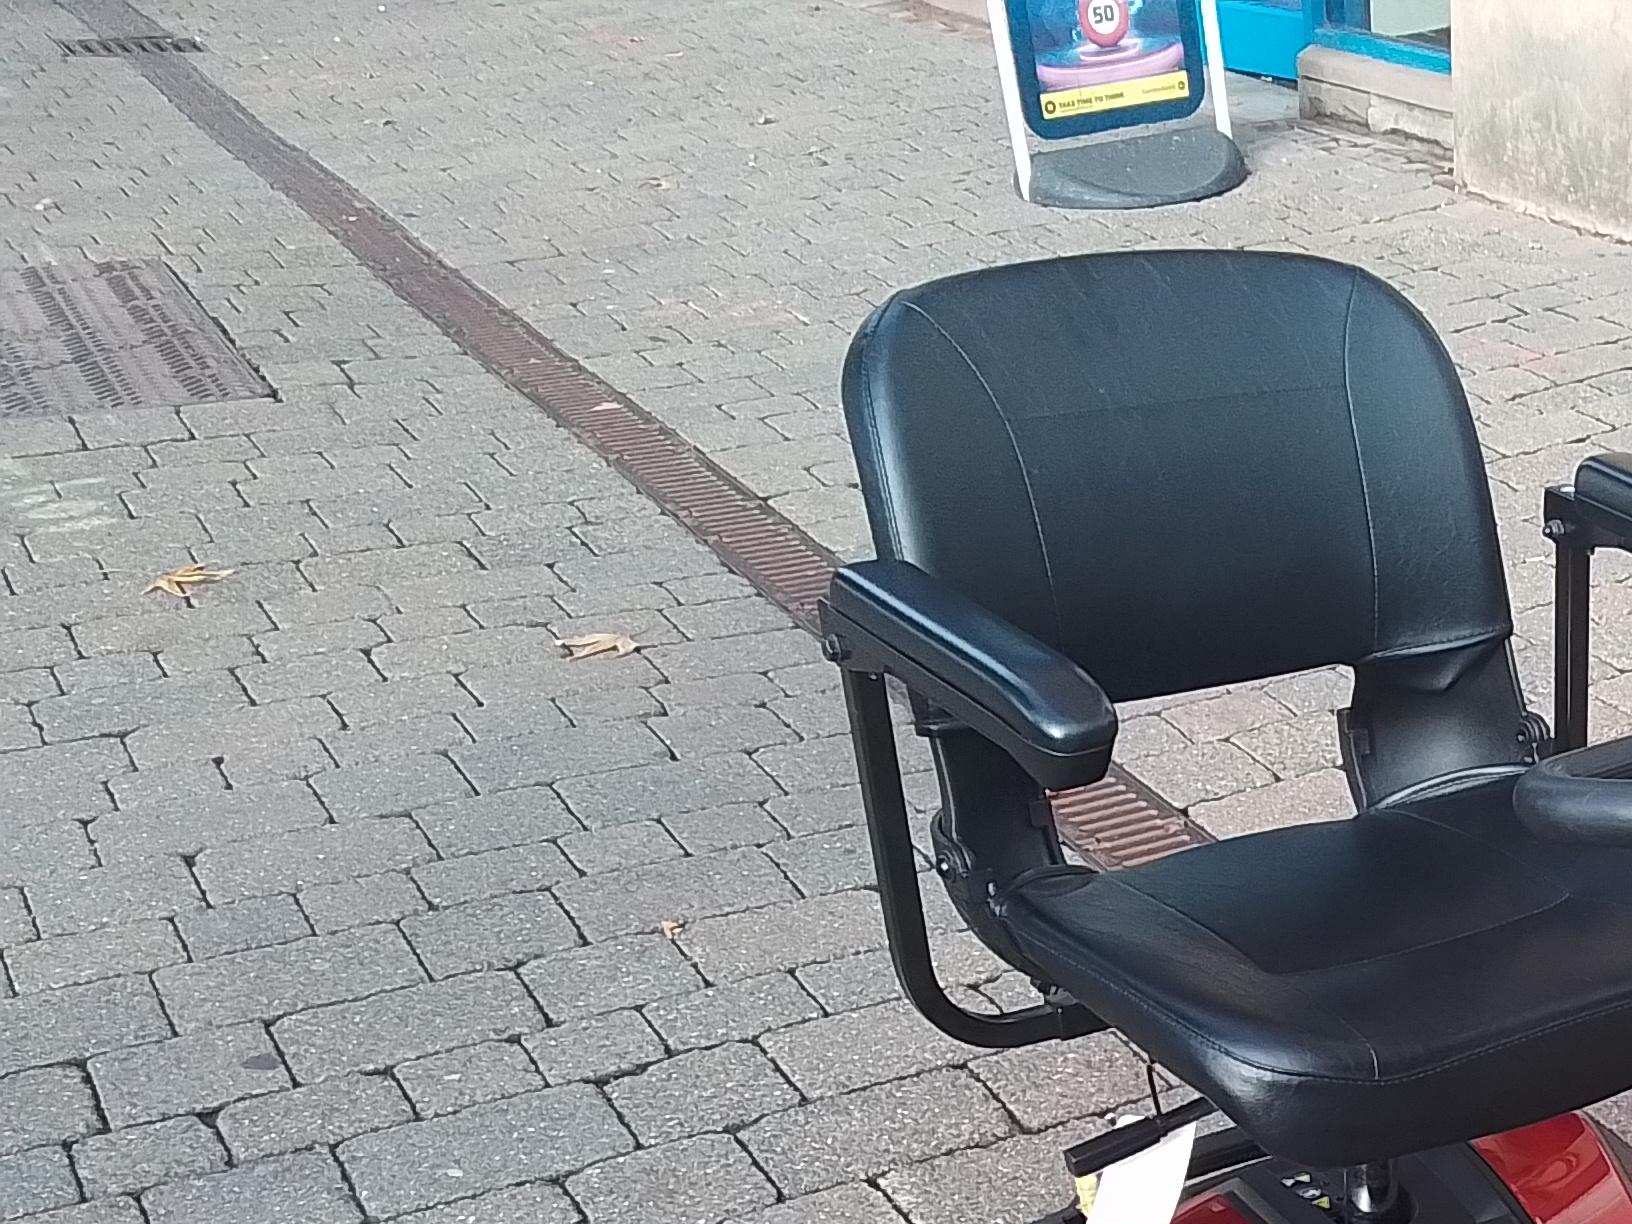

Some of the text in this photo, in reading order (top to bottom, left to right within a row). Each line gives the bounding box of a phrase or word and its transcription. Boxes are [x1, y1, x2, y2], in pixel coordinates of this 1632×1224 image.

[1093, 5, 1115, 24] 50
[1077, 98, 1093, 106] TIME
[1094, 95, 1104, 103] TO
